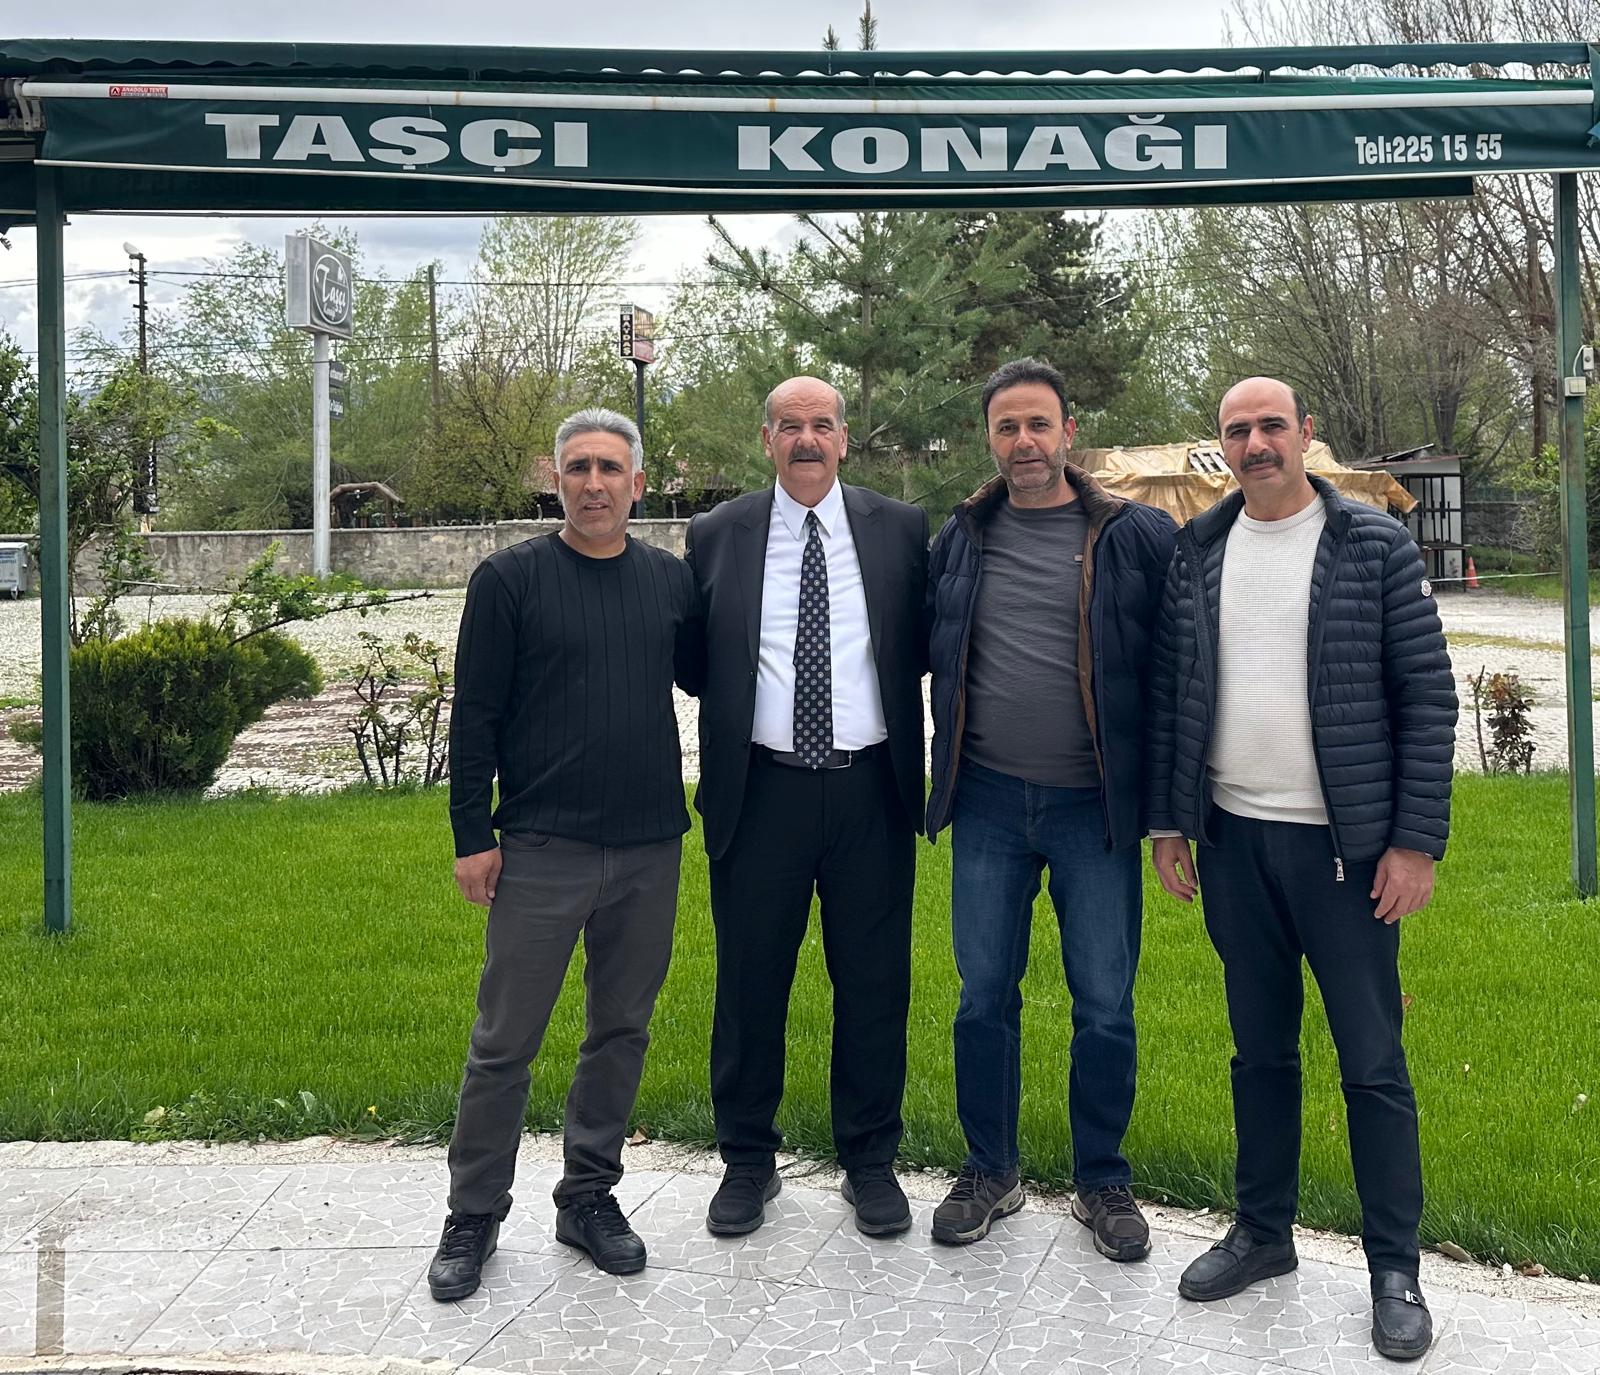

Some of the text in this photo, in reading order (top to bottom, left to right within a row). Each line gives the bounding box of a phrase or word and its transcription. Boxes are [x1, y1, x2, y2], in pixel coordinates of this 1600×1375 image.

[205, 113, 1227, 173] TAŞÇI KONAĞI
[1355, 134, 1502, 164] Tel:225 15 55
